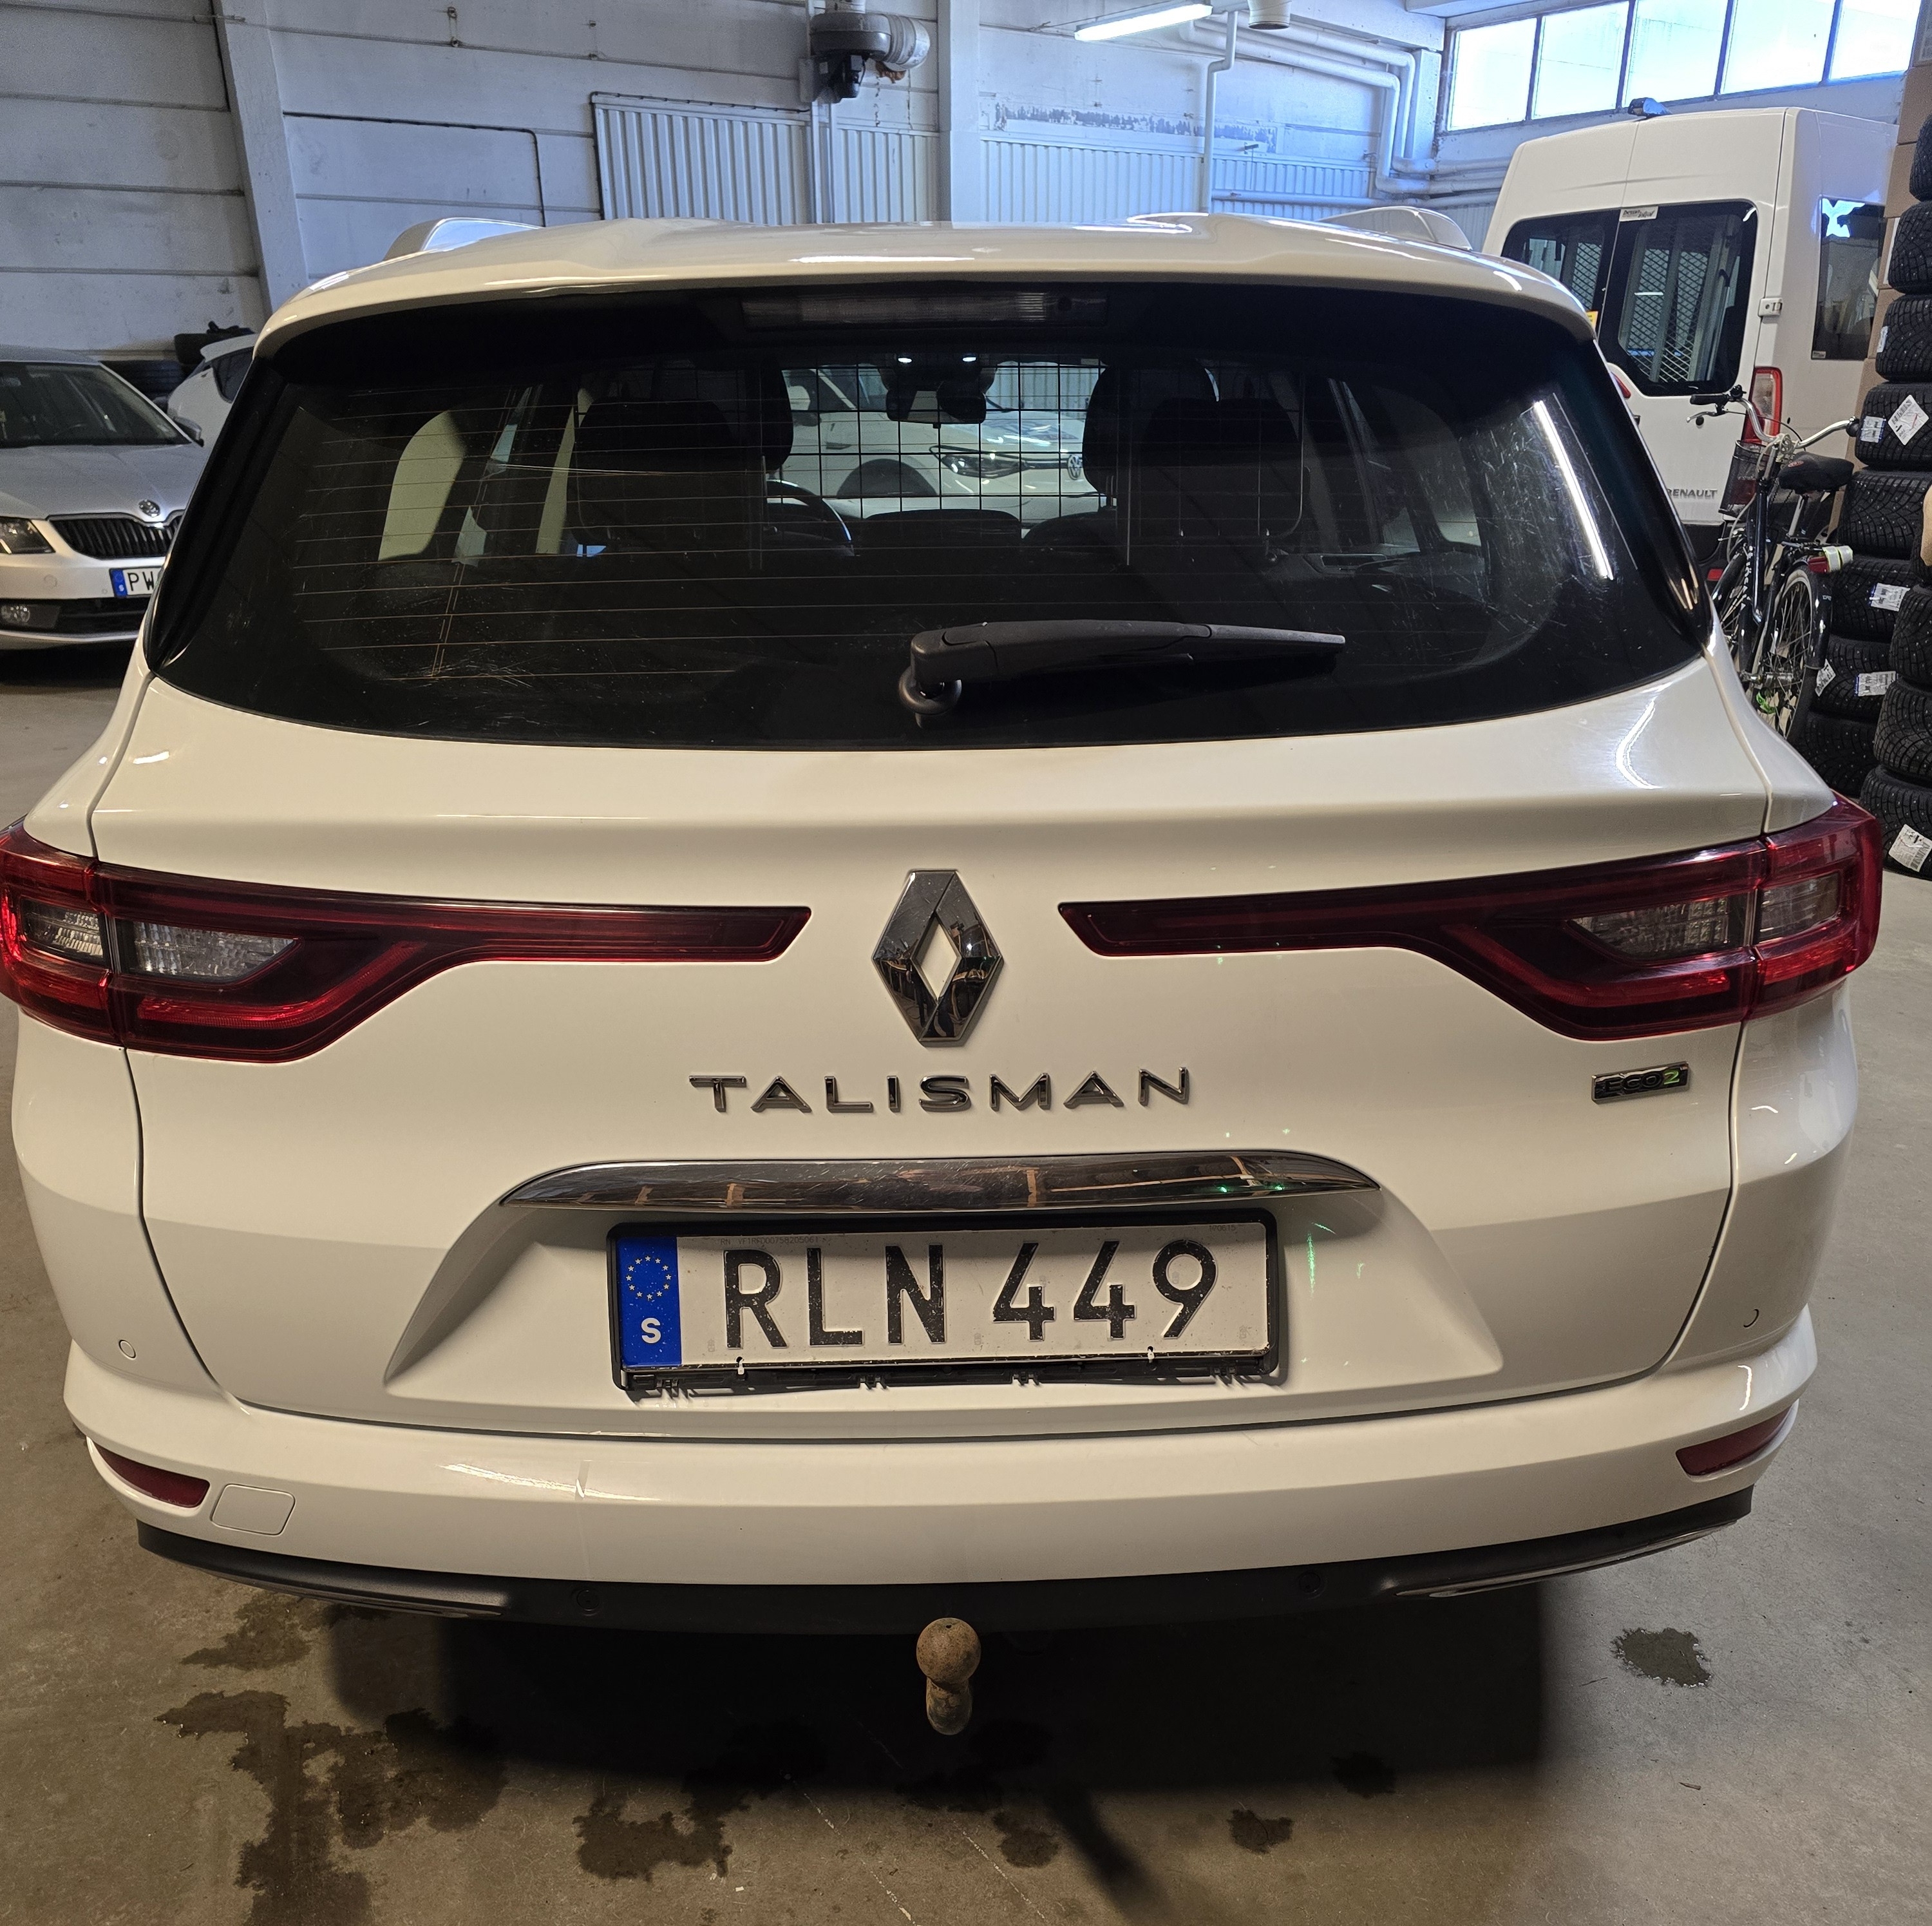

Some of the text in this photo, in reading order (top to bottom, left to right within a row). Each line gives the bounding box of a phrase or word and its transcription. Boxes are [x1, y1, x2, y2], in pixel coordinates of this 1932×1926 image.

[1666, 489, 1718, 497] RENAULT
[128, 571, 155, 591] PW
[688, 1067, 1189, 1112] TALISMAN
[723, 1239, 1217, 1348] RLN 449
[641, 1317, 661, 1344] S
